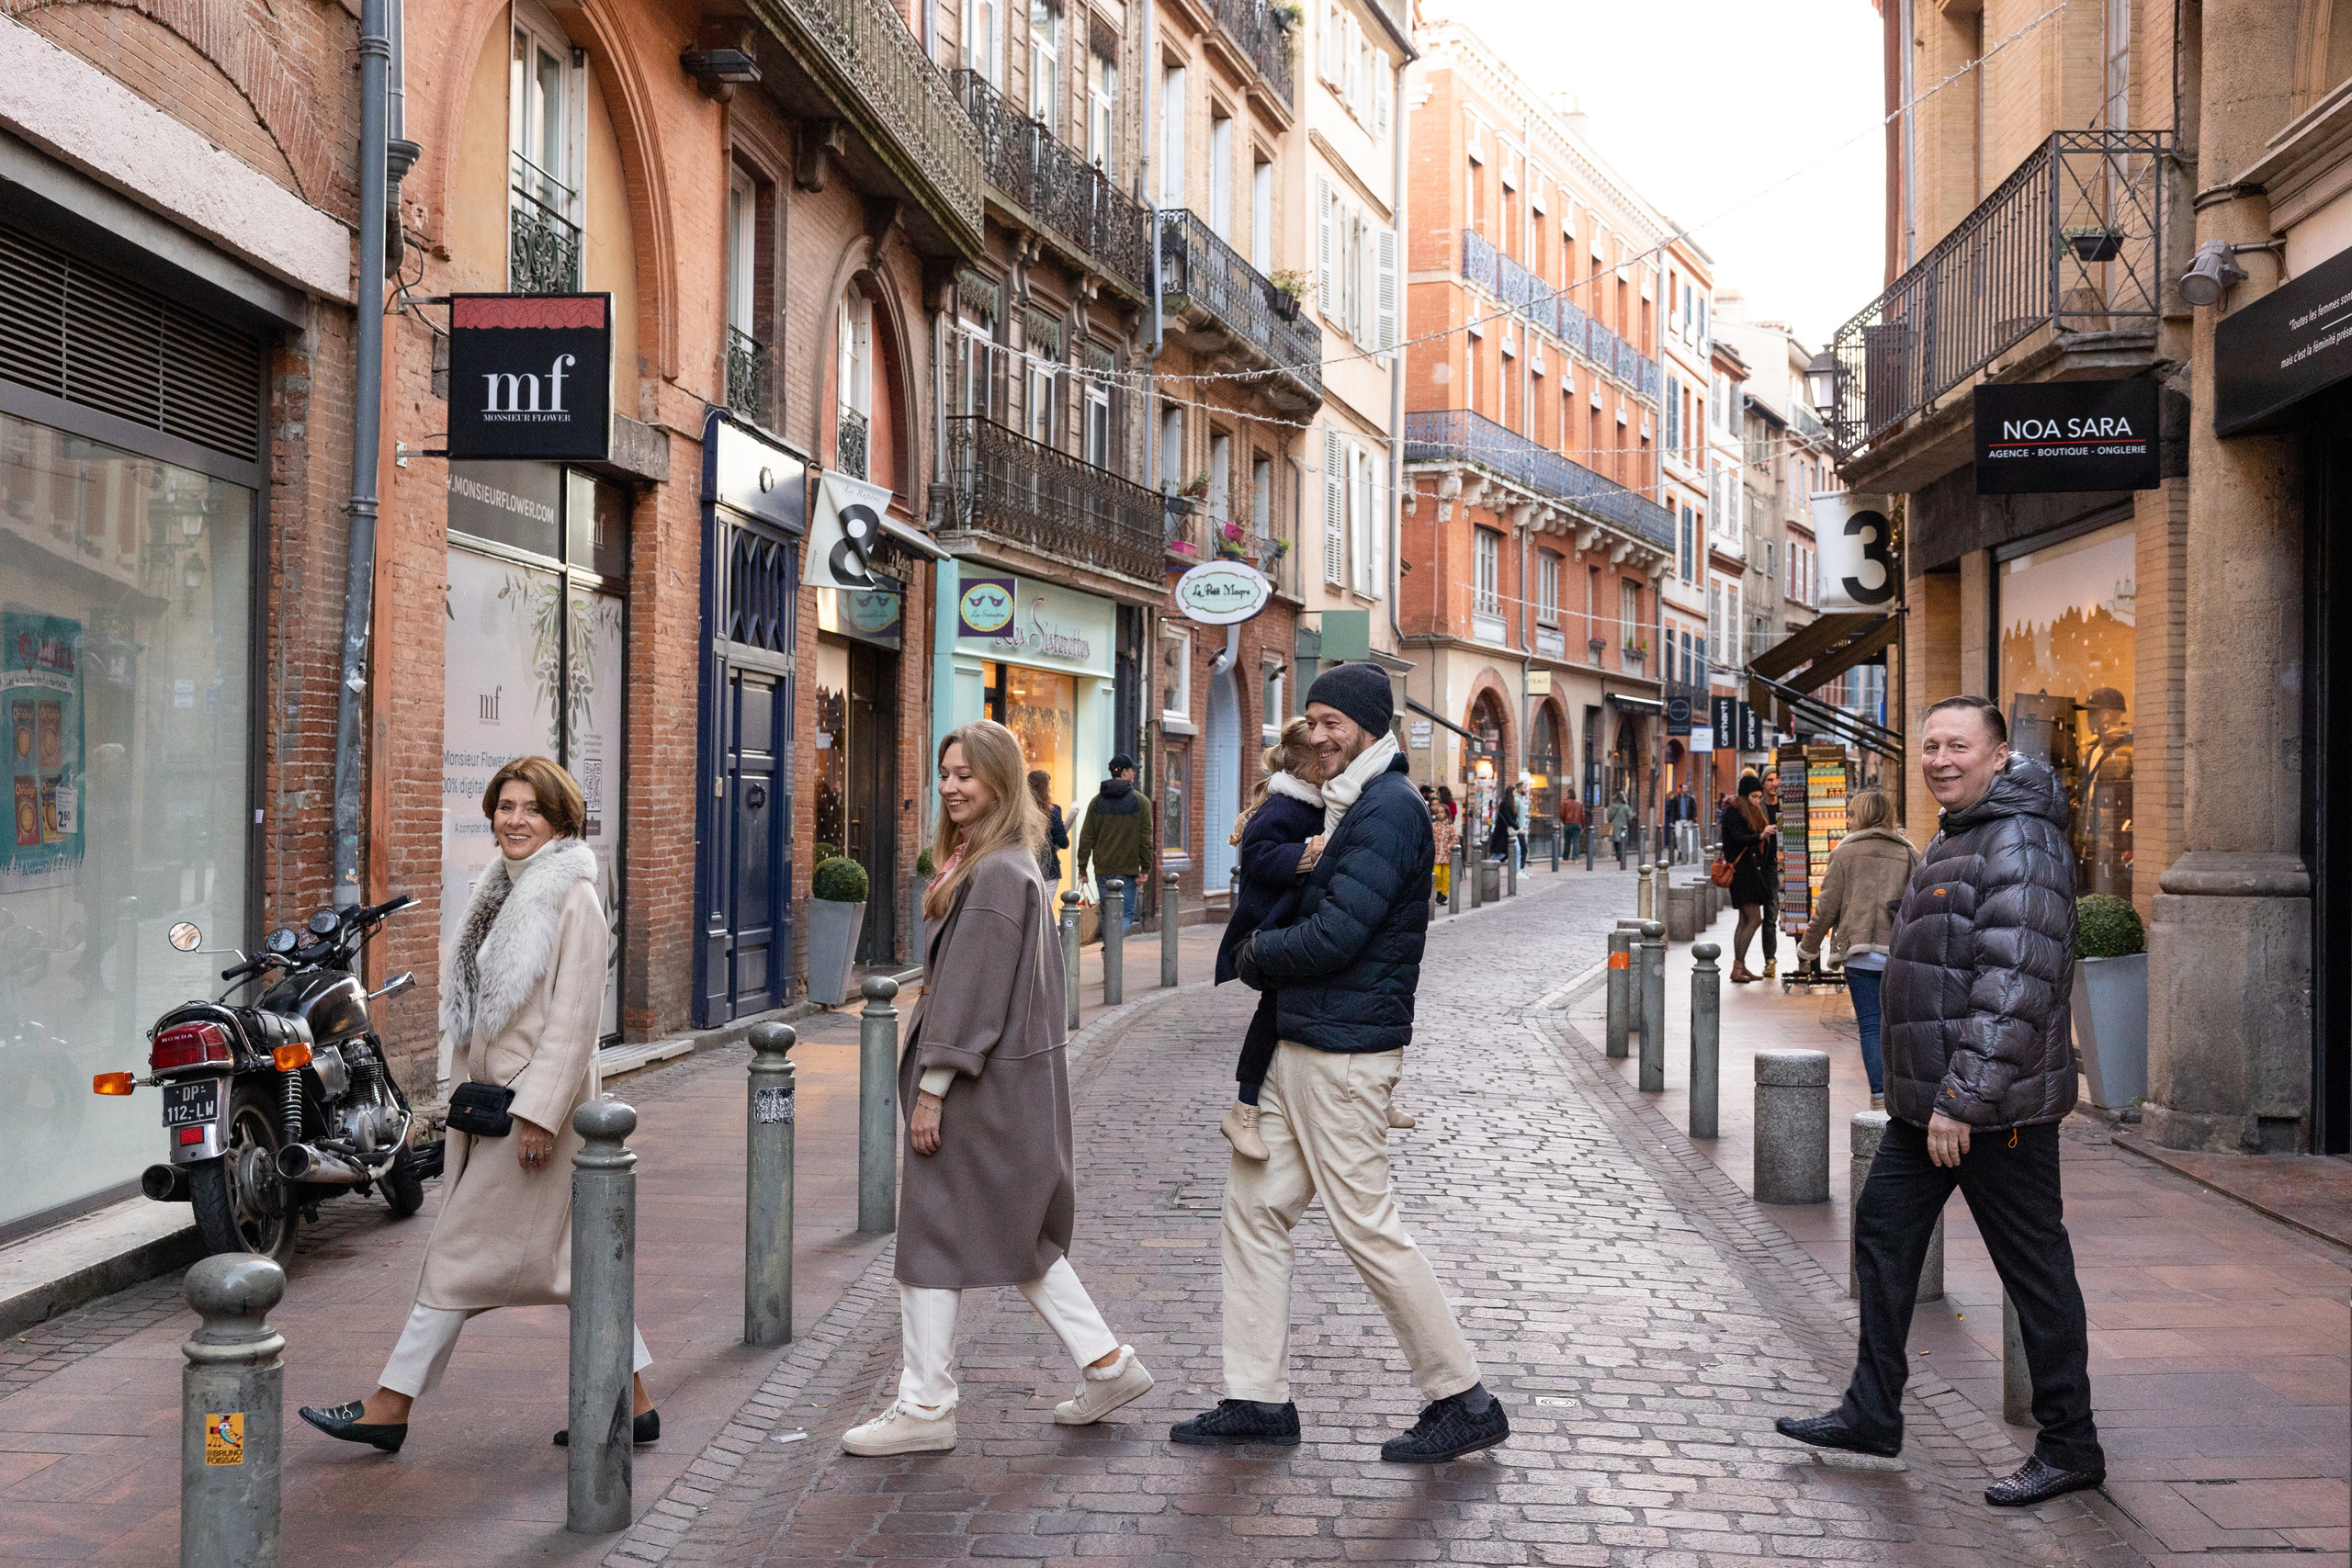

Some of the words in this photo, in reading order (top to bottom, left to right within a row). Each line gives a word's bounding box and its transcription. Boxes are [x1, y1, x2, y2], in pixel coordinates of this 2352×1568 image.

[2309, 309, 2317, 321] les
[2318, 303, 2340, 318] femmes
[2280, 354, 2293, 369] mais
[2306, 344, 2312, 356] la
[481, 354, 576, 412] mf
[483, 413, 530, 423] MONSIEUR
[532, 413, 571, 423] FLOWER
[2003, 419, 2062, 440] NOA
[2067, 416, 2133, 439] SARA
[1988, 447, 2030, 458] AGENCE
[2037, 446, 2089, 457] BOUTIQUE
[2097, 445, 2147, 455] ONGLERIE
[1841, 510, 1896, 605] 3
[1192, 583, 1204, 597] Le
[479, 683, 503, 720] mf
[1720, 699, 1729, 747] carhartt
[1747, 705, 1756, 750] carhart
[443, 750, 479, 766] Monsieur
[481, 752, 505, 768] Flower
[460, 778, 485, 799] digital
[161, 1033, 194, 1043] HONDA
